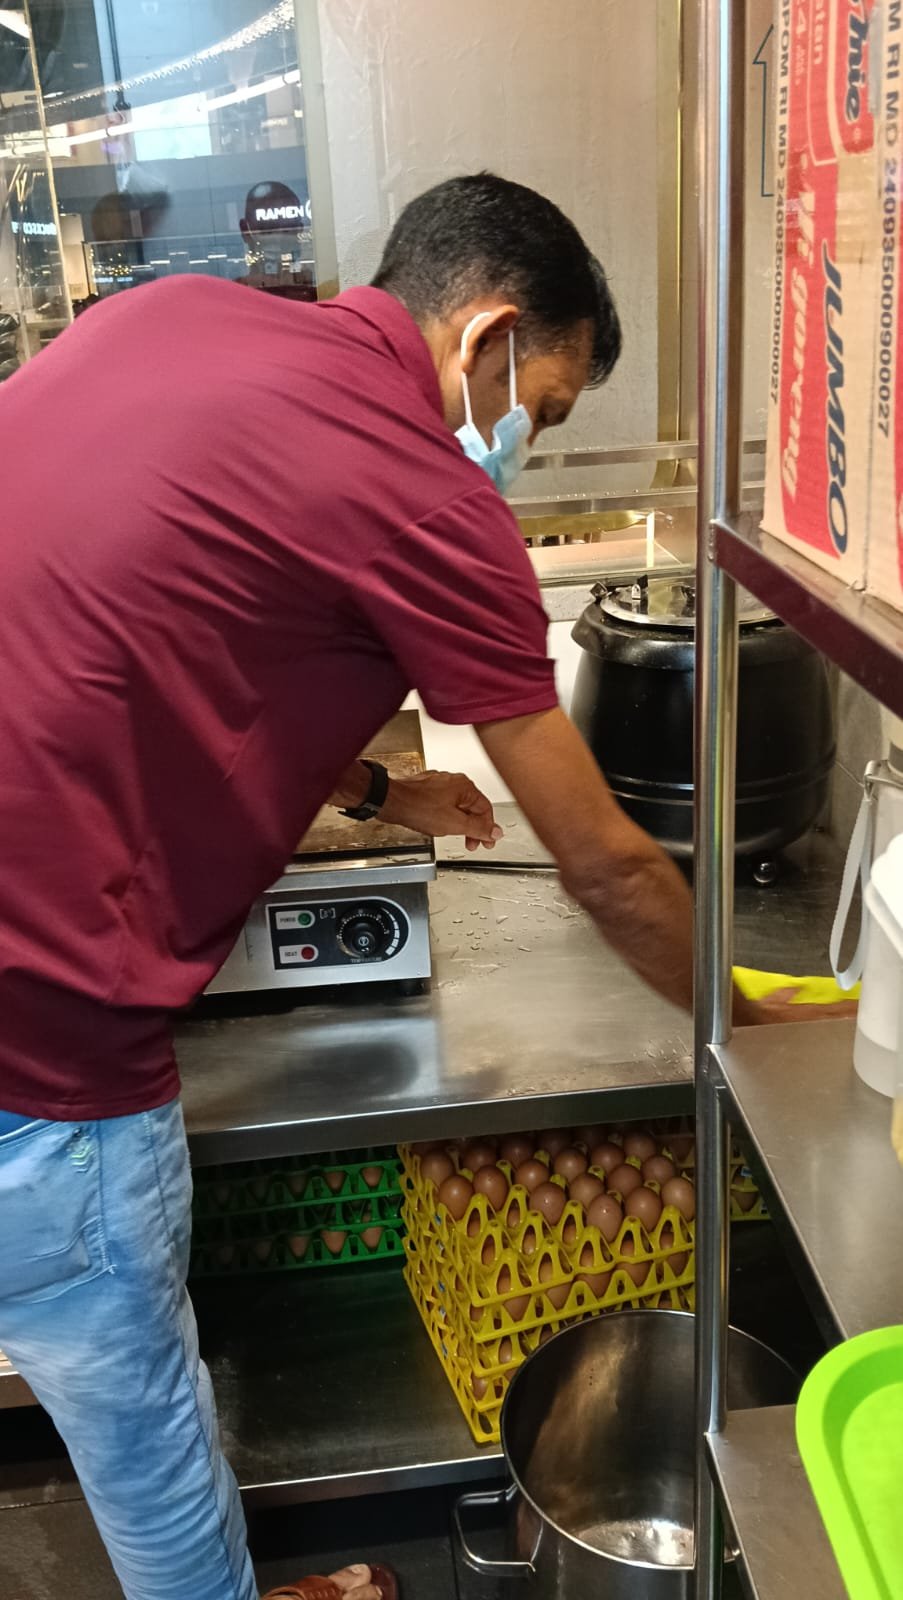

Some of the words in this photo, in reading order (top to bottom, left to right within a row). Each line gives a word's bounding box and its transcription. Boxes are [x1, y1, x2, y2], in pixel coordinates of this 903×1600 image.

[779, 87, 788, 115] RI
[845, 0, 869, 122] mie
[886, 43, 900, 79] RI
[777, 124, 787, 168] MD
[885, 91, 899, 148] MD
[255, 205, 304, 221] RAMEN
[770, 178, 785, 405] 240935000900027
[877, 158, 897, 438] 240935000900027
[781, 267, 808, 503] goreng
[821, 238, 848, 554] JUMBO
